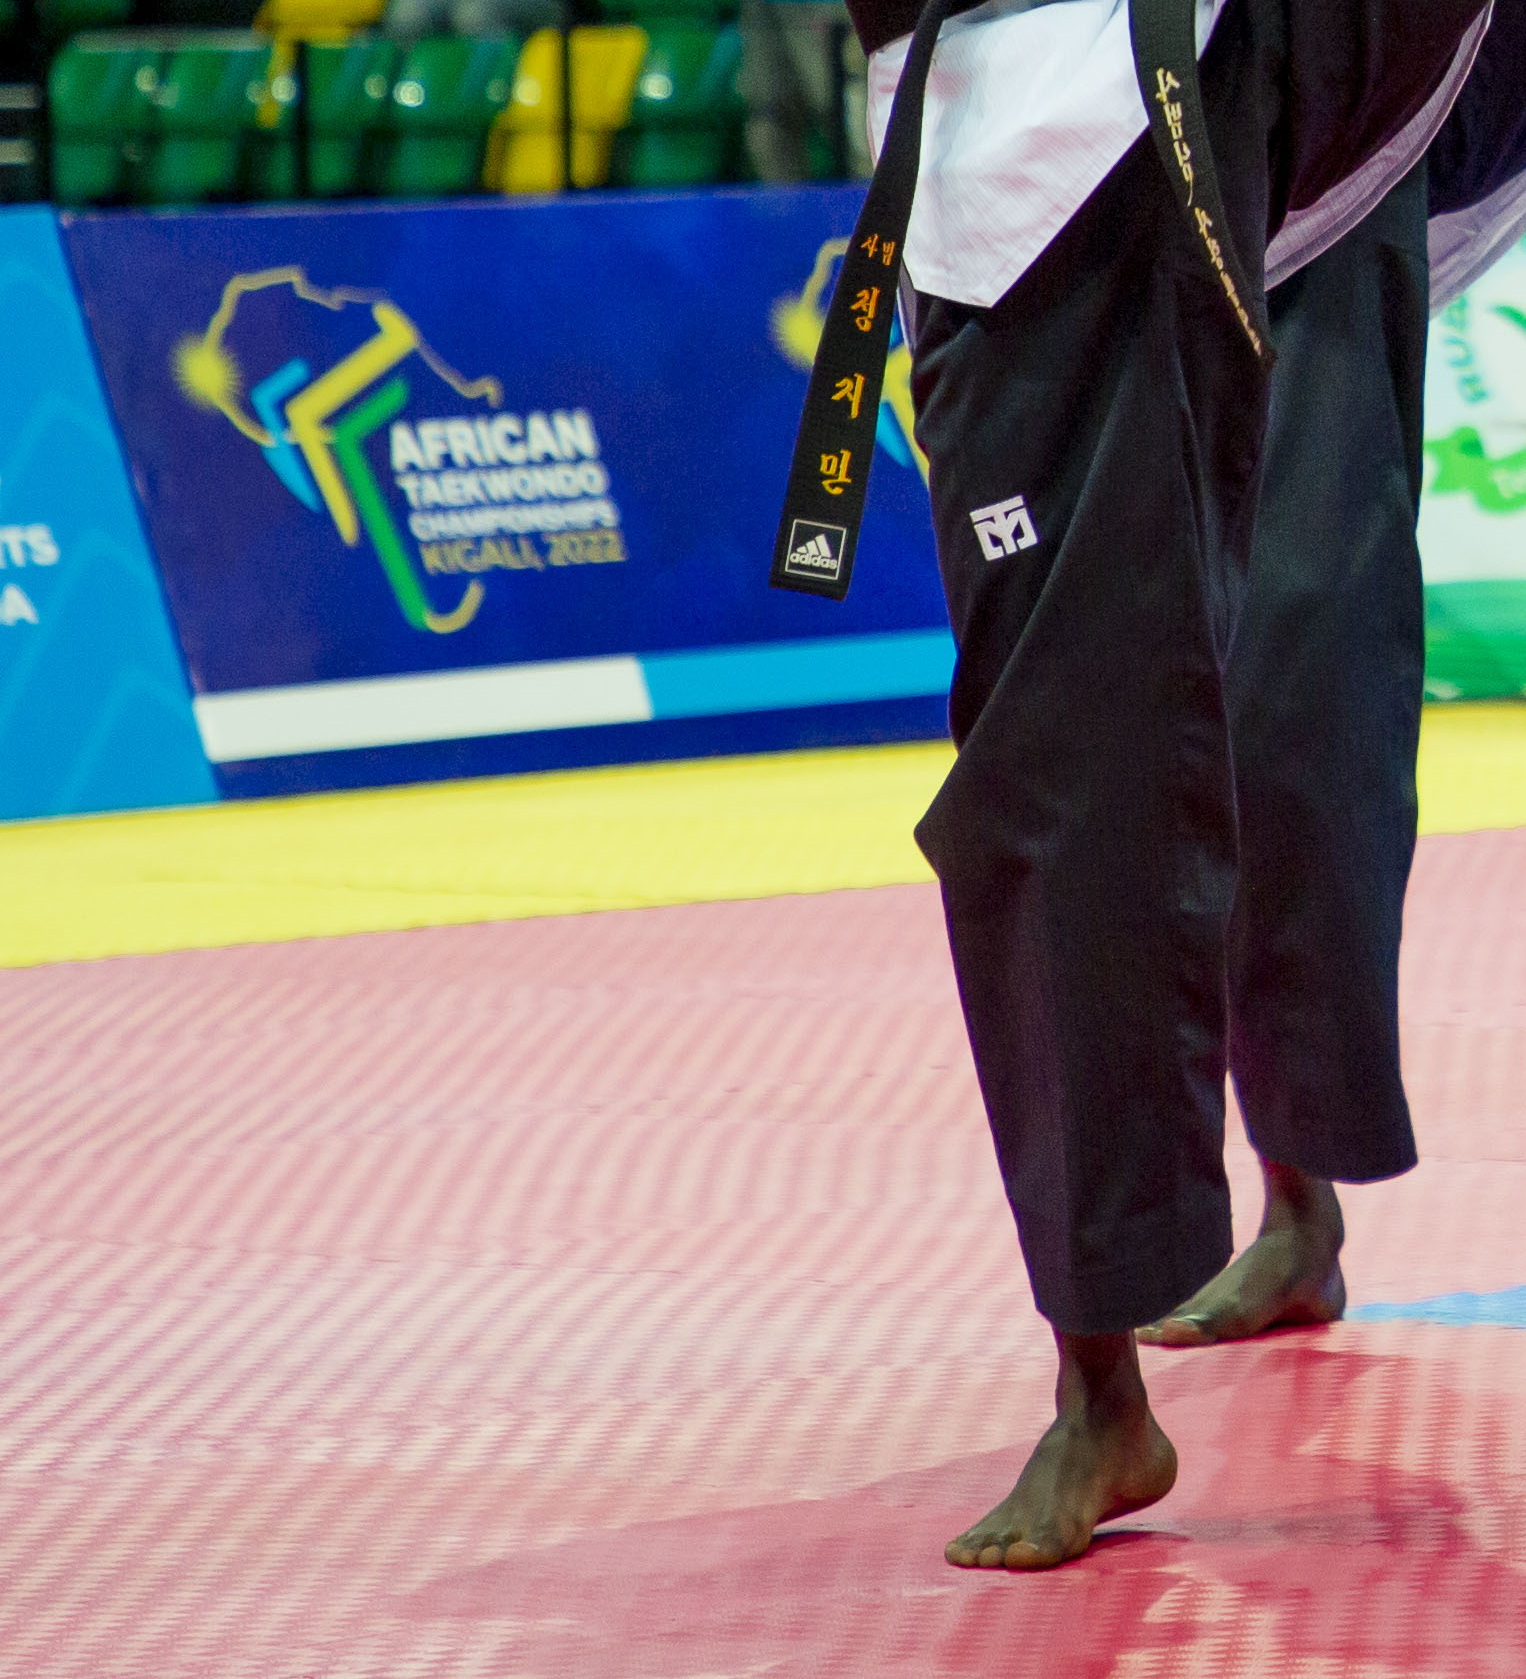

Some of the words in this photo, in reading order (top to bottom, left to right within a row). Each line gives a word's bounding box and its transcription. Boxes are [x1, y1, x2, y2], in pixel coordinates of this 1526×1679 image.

[391, 409, 599, 471] AFRICAN
[396, 462, 609, 508] TAEKWONDO
[790, 551, 838, 571] adidas
